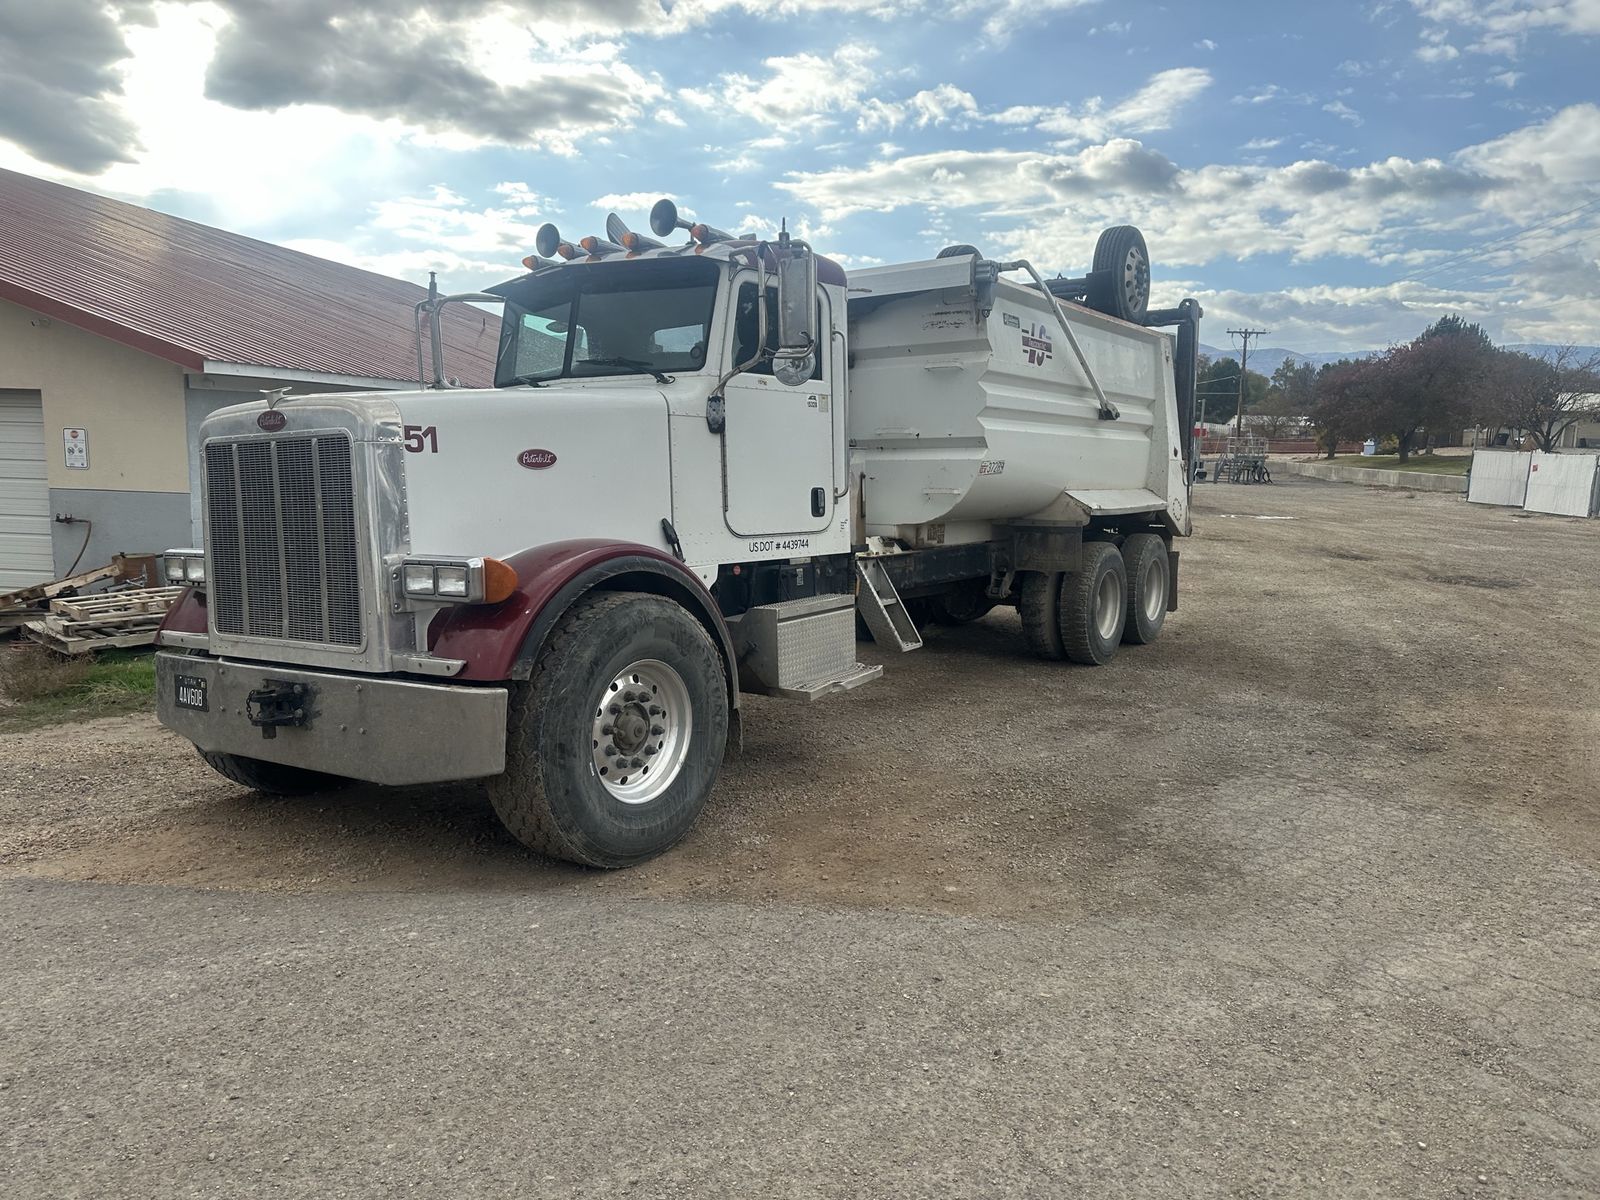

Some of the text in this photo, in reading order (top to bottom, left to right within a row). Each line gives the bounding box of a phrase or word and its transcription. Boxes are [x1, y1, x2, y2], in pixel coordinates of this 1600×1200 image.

[404, 425, 438, 453] 51
[522, 451, 554, 464] Peterbilt
[782, 539, 809, 550] 4439744
